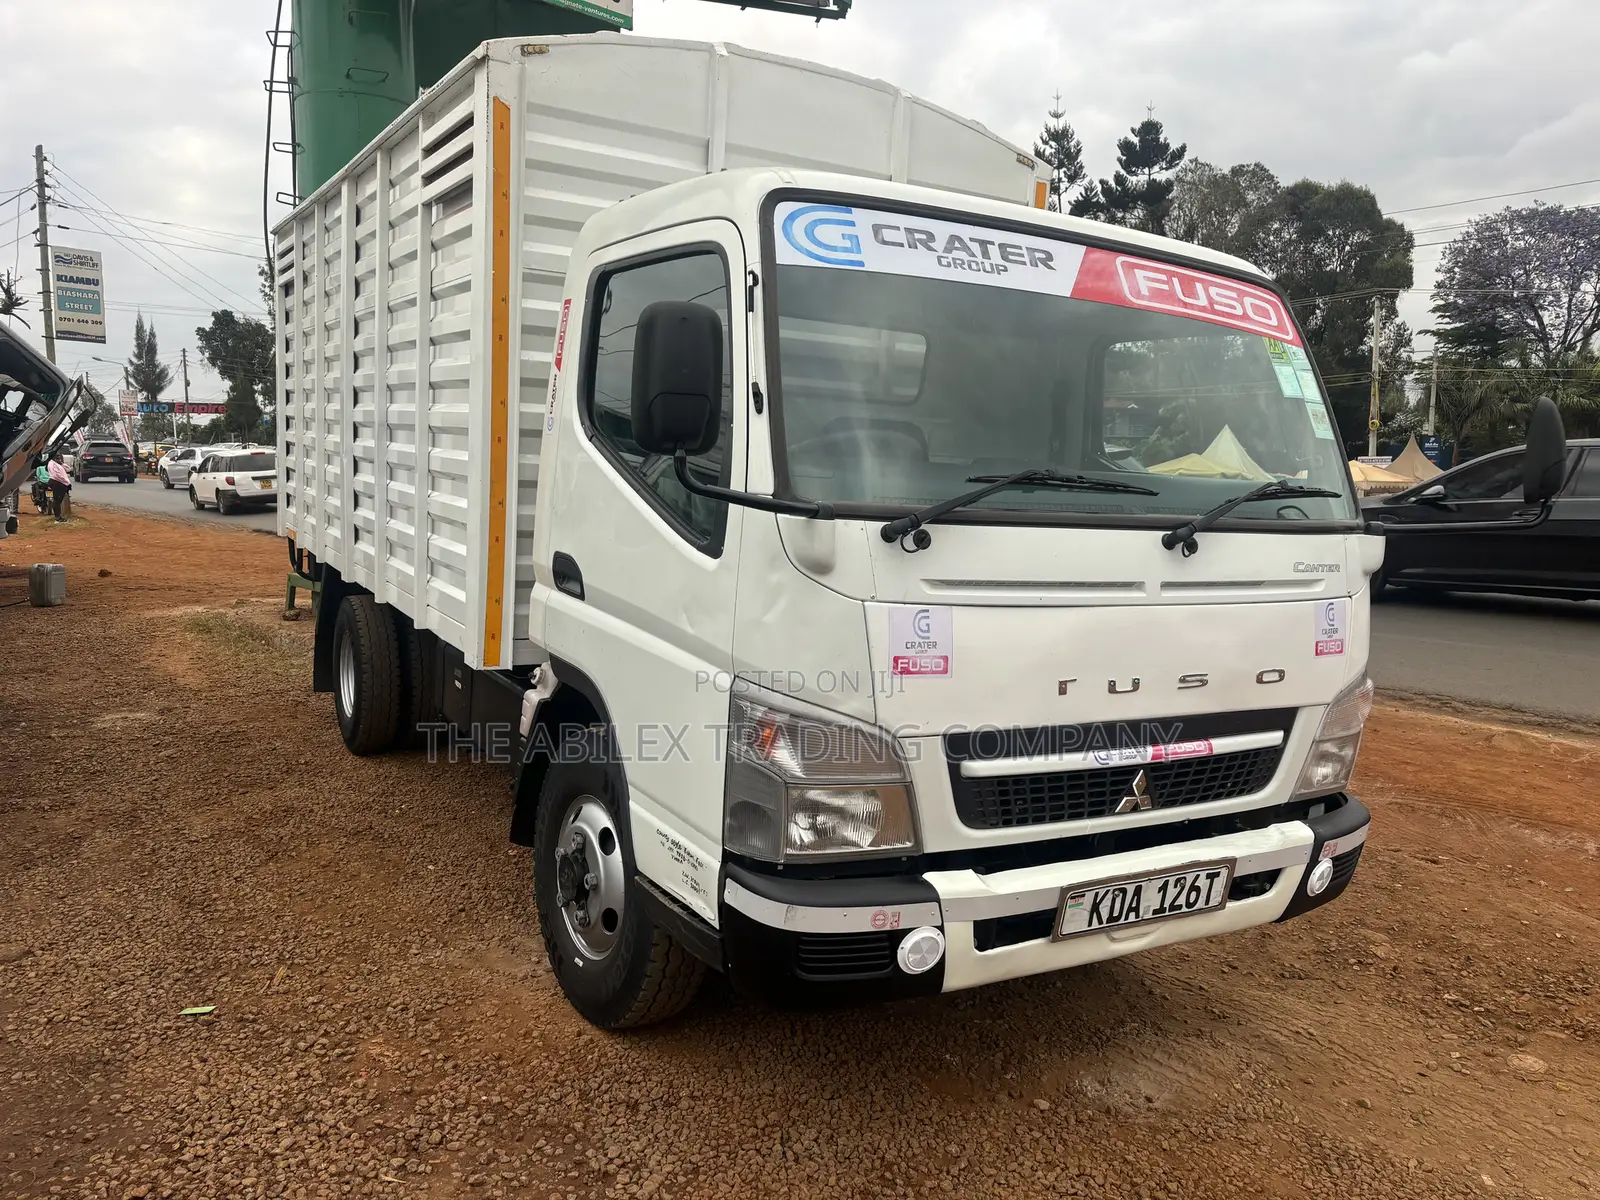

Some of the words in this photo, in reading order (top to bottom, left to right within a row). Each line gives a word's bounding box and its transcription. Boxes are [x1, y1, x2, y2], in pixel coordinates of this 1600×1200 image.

[871, 223, 1057, 271] CRATER
[936, 256, 1009, 276] GROUP
[56, 274, 100, 286] KIAMBU
[57, 289, 100, 300] BIASHARA
[1134, 268, 1279, 326] FUSO
[64, 302, 93, 311] STREET
[137, 403, 169, 413] Auto
[174, 402, 227, 415] Empire
[905, 641, 937, 649] CRATER
[1317, 641, 1342, 654] FUSO
[898, 659, 944, 671] FUSO
[1165, 741, 1205, 753] FUSO
[1087, 884, 1143, 928] KDA
[1151, 871, 1221, 916] 126T
